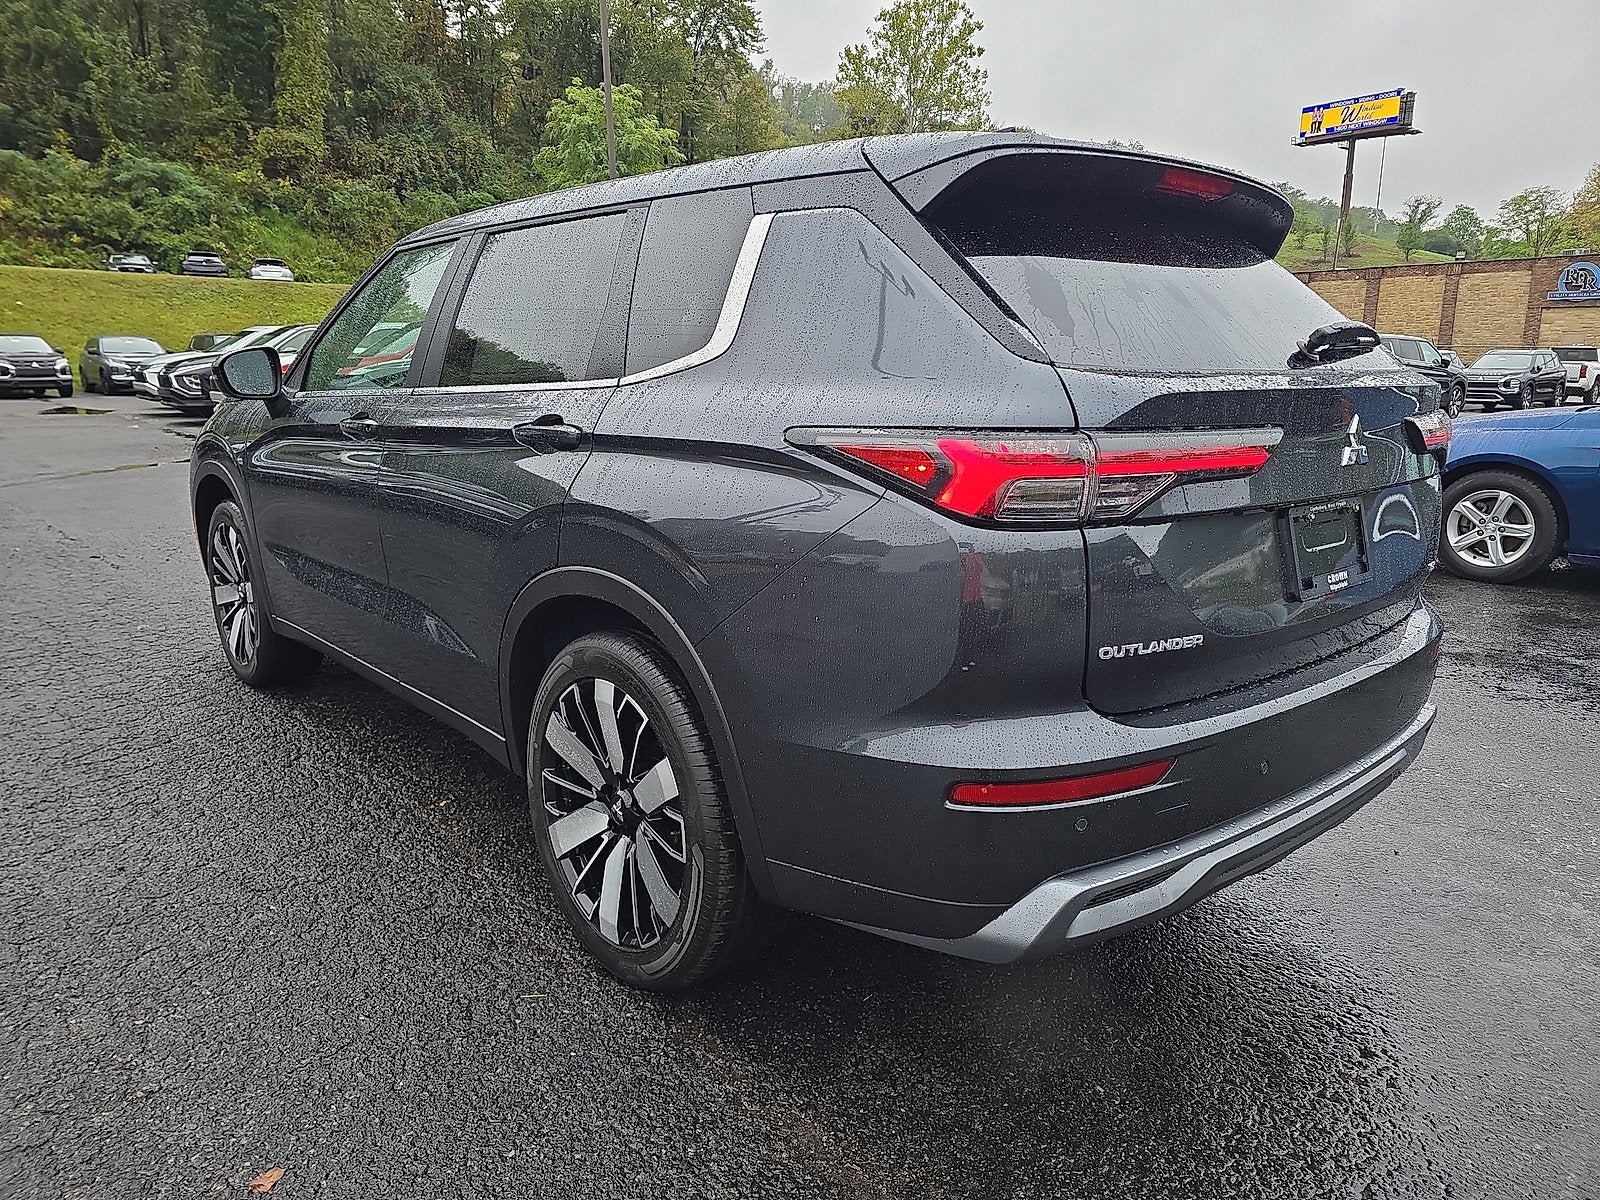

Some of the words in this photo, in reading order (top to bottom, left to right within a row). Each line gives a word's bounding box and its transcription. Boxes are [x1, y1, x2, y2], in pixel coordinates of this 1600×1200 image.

[1329, 100, 1354, 109] WINDOWS
[1358, 95, 1376, 104] SIDING
[1379, 90, 1398, 100] DOORS
[1341, 103, 1384, 124] Window
[1348, 122, 1363, 130] NEXT
[1363, 118, 1388, 128] WINDOW
[1327, 570, 1349, 584] CROWN
[1098, 634, 1204, 660] OUTLANDER
